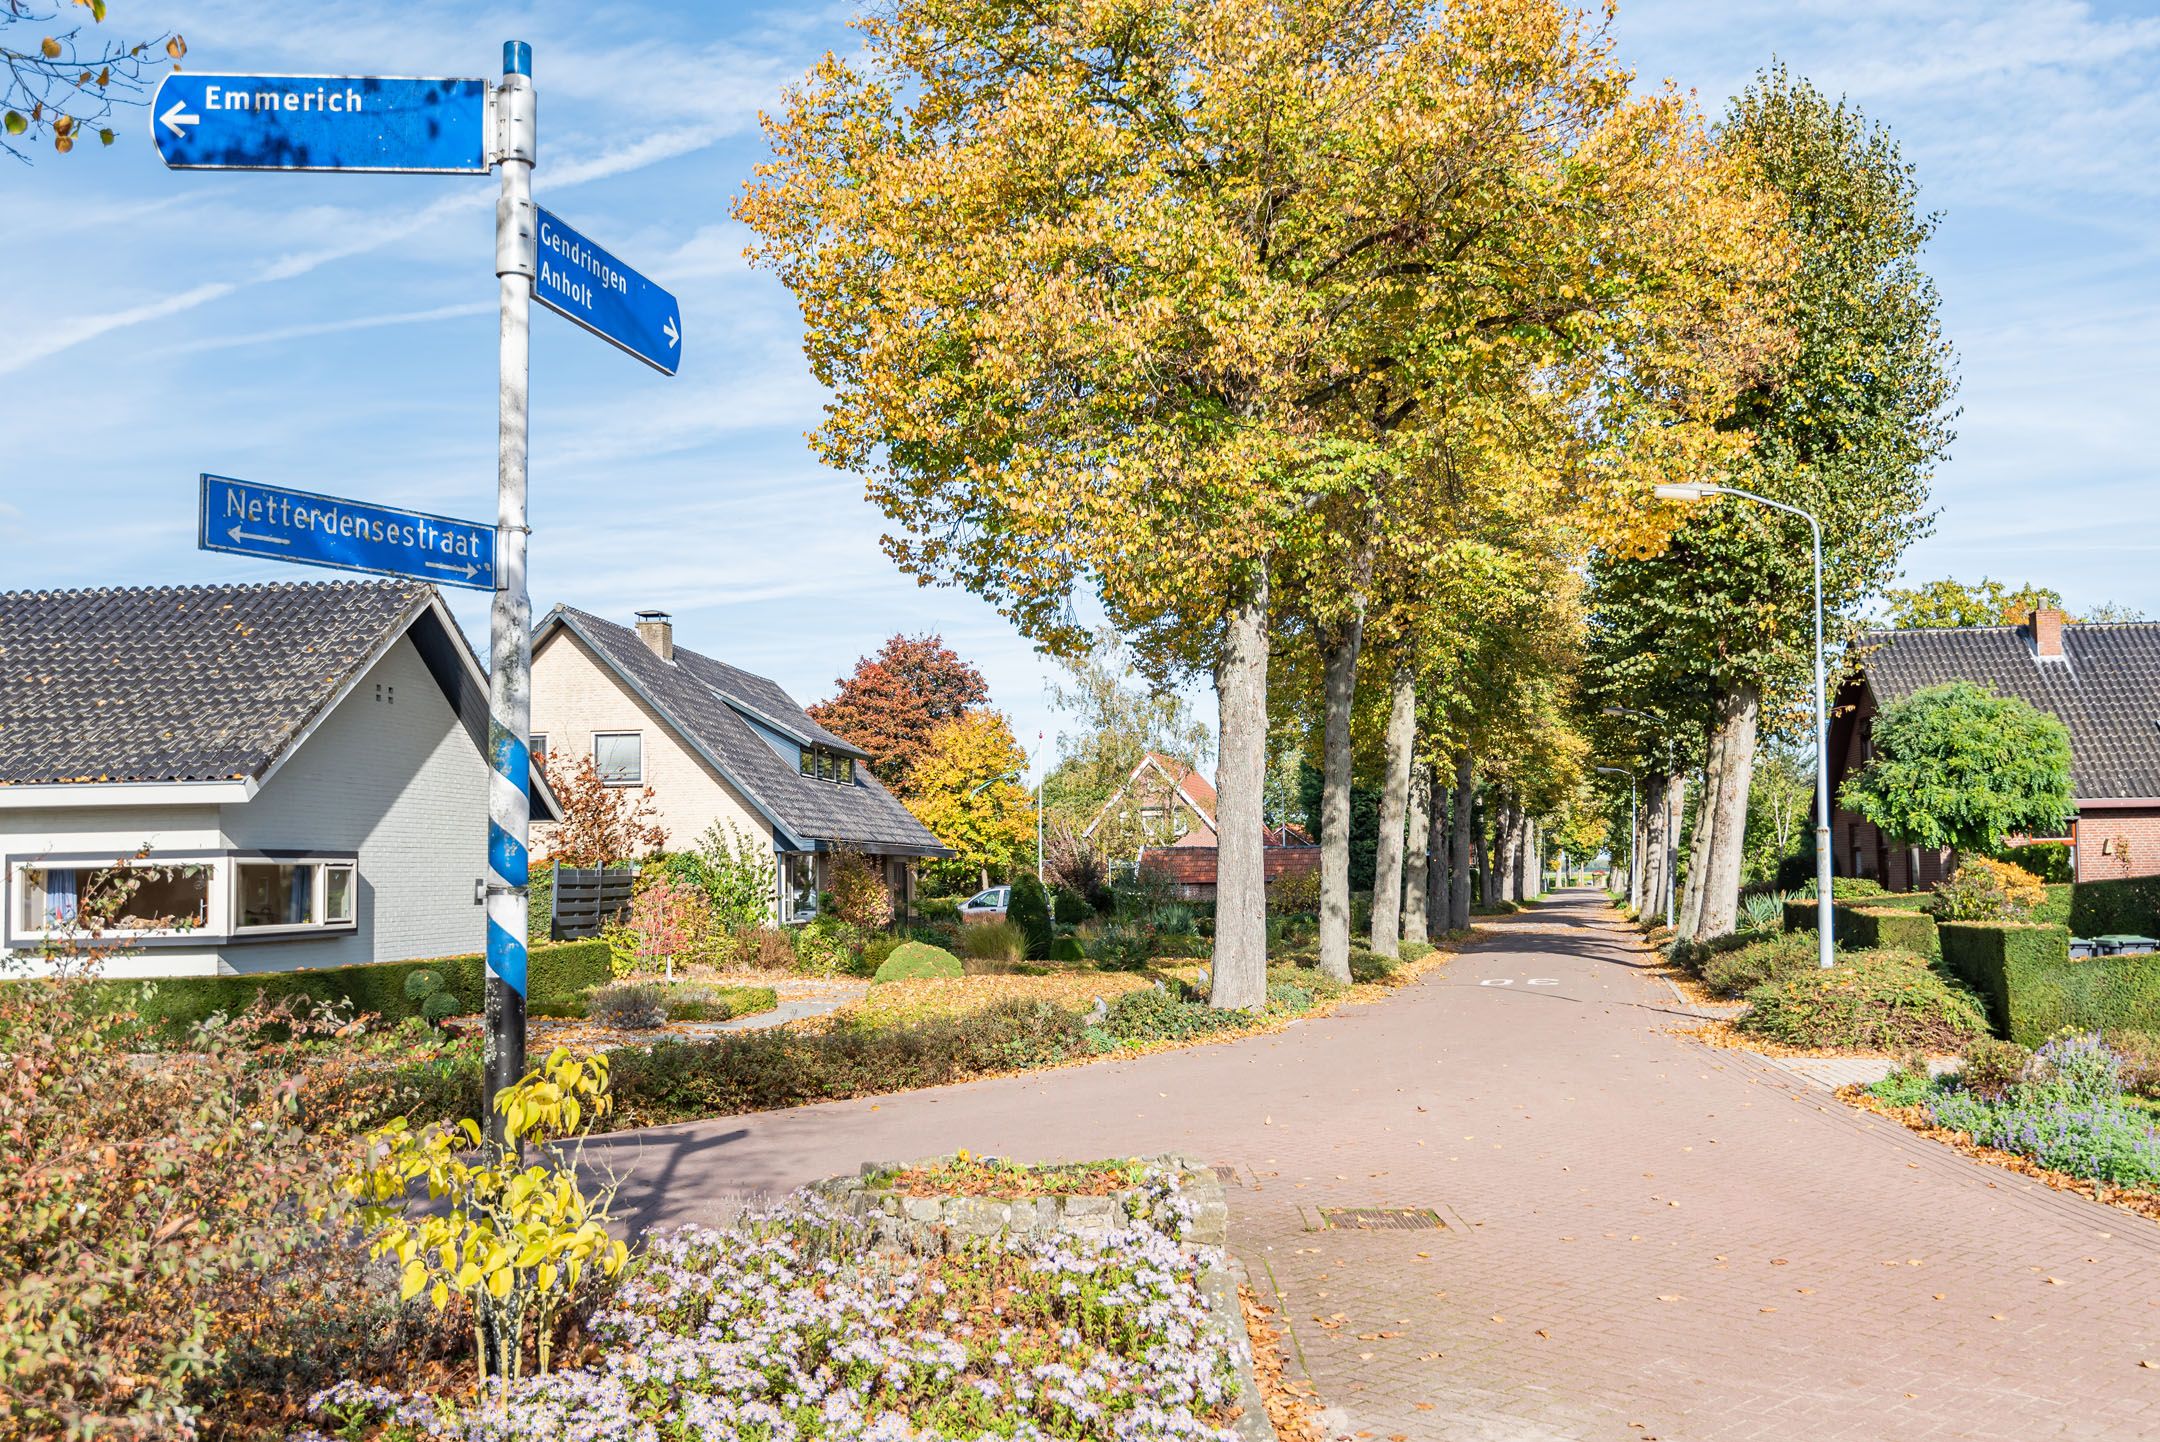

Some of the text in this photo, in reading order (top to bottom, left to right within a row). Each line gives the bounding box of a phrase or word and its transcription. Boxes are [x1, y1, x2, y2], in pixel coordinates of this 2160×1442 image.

[205, 85, 362, 112] Emmerich
[540, 261, 592, 310] Anholt
[541, 222, 627, 294] Gendringen
[226, 488, 480, 558] Netterdensestraat
